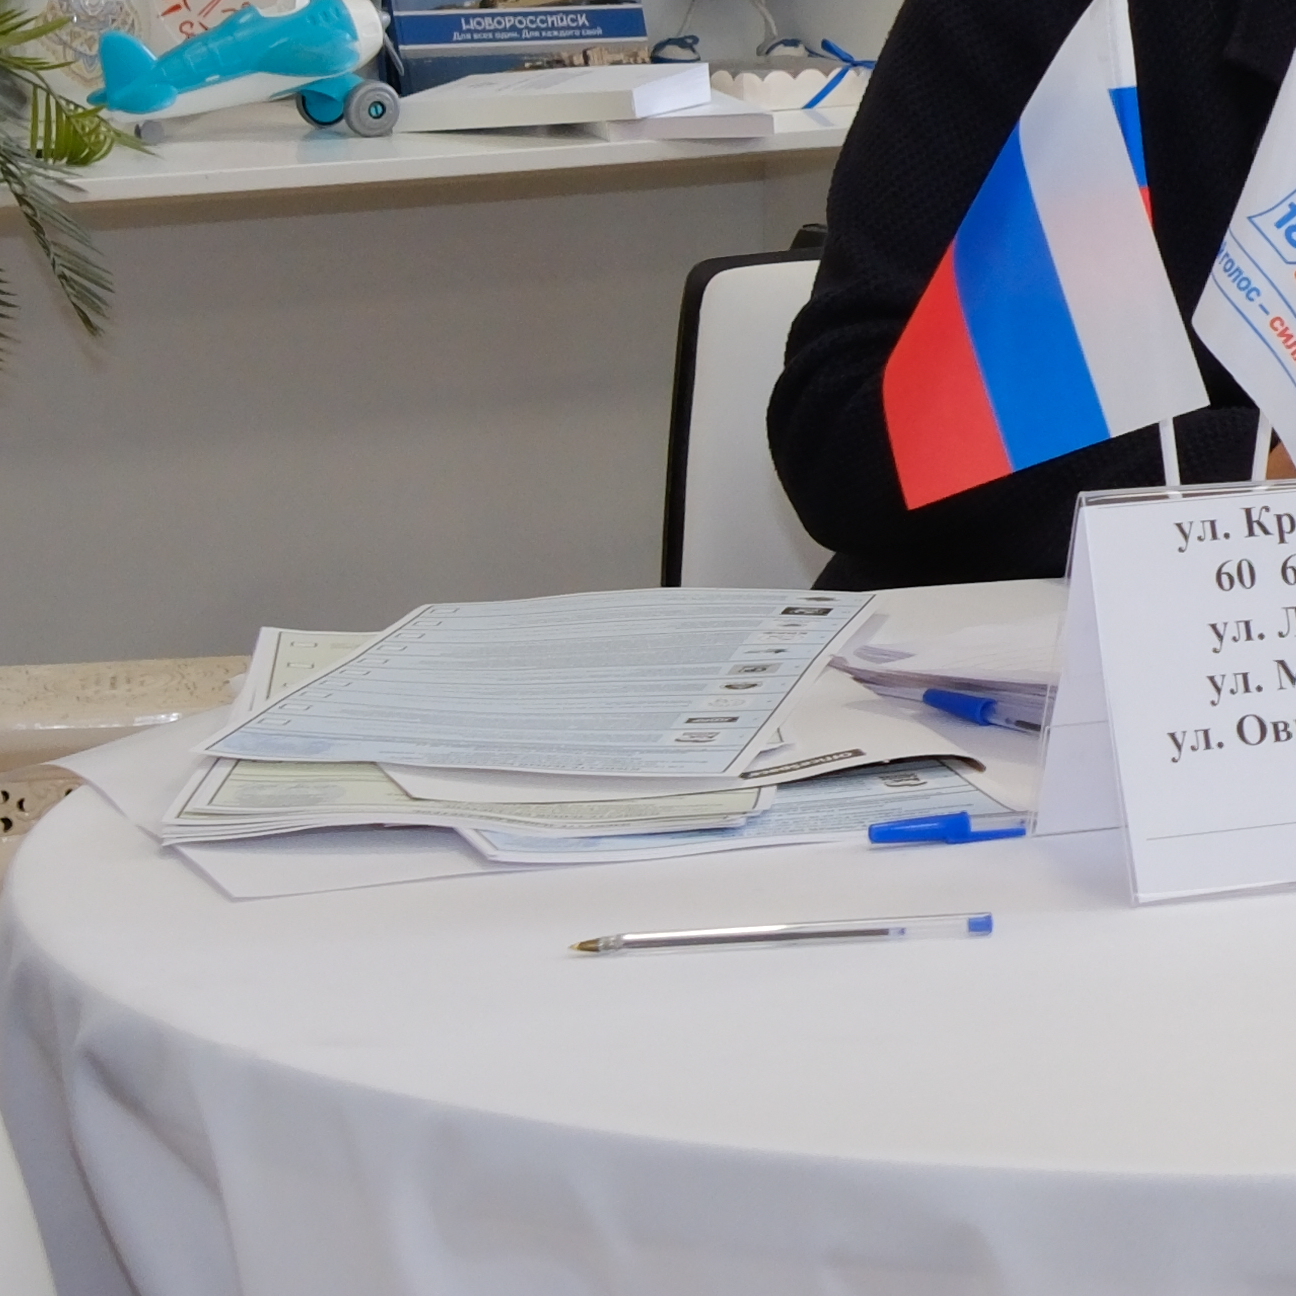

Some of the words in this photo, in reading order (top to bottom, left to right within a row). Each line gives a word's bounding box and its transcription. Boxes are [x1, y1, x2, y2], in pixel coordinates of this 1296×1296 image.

[1174, 517, 1231, 553] ул.
[1215, 558, 1256, 592] 60
[1207, 617, 1266, 653] ул.
[1206, 670, 1263, 706] ул.
[1166, 727, 1225, 763] ул.
